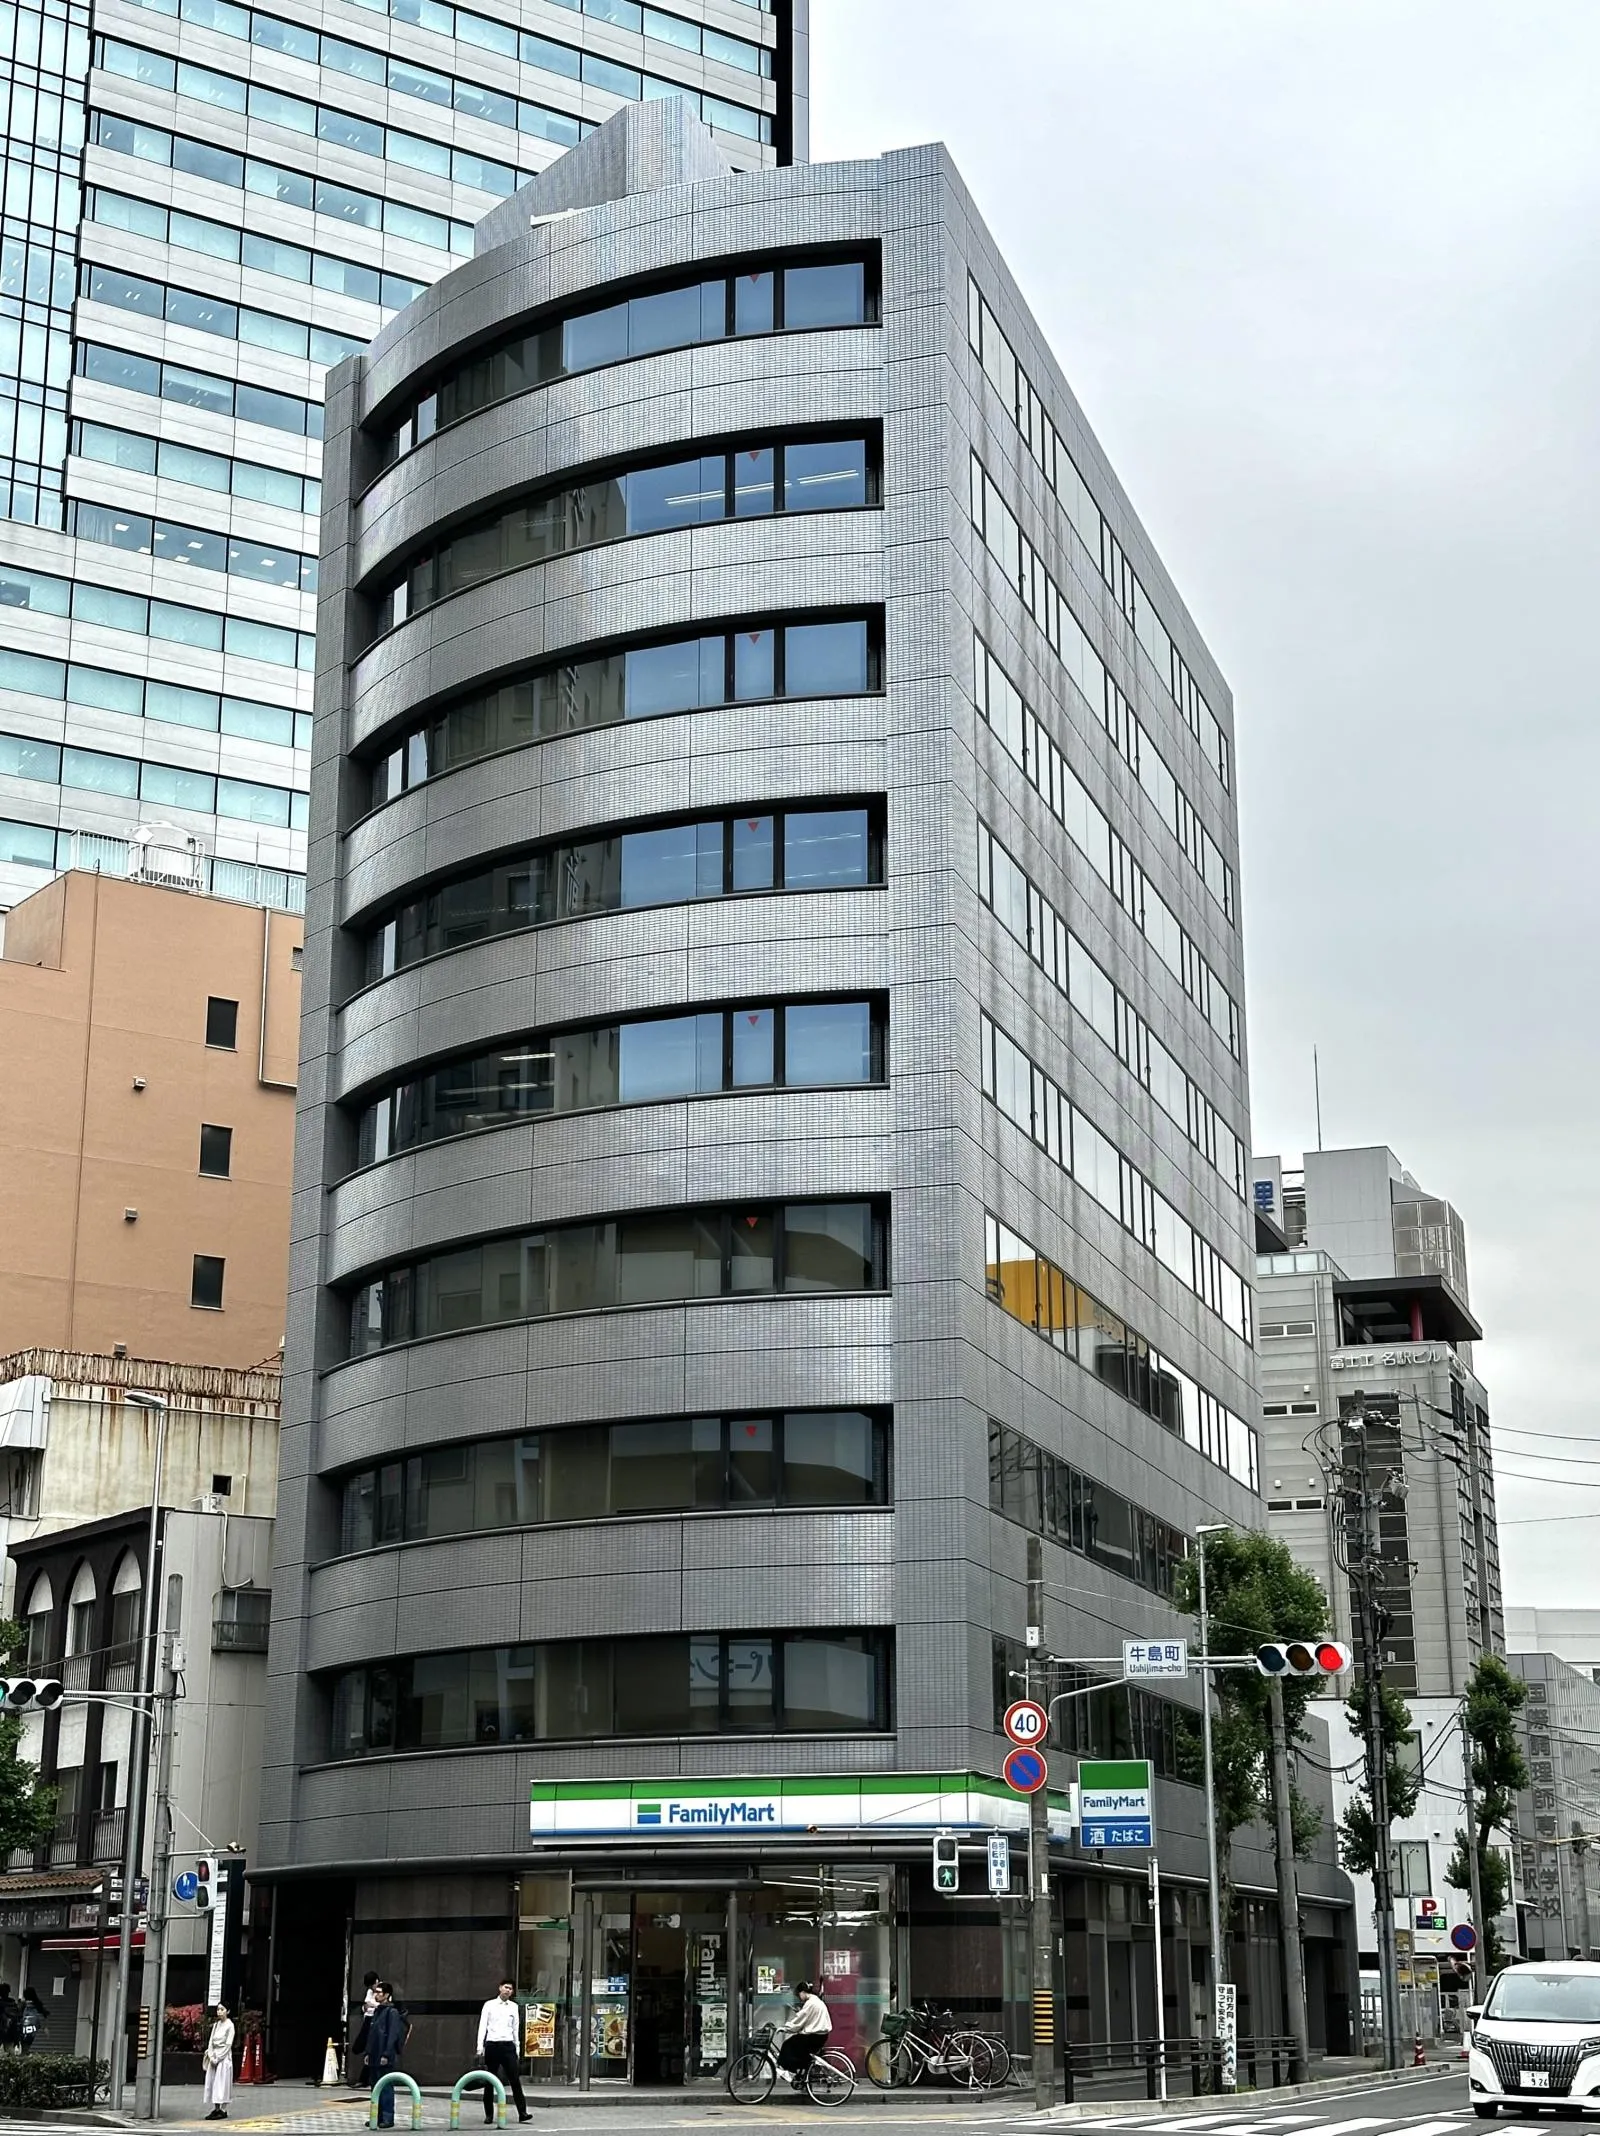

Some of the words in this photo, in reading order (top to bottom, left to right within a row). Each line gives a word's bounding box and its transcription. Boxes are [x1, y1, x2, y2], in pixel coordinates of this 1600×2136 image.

[1330, 1353, 1375, 1369] 富士工
[1381, 1350, 1441, 1366] 名駅ビル
[1130, 1646, 1180, 1661] 牛島町
[1129, 1664, 1182, 1674] Ushijima-cho
[1015, 1714, 1037, 1733] 40
[1083, 1796, 1145, 1810] FamilyMart
[669, 1802, 775, 1825] FamilyMart
[1089, 1828, 1105, 1844] 酒
[1111, 1830, 1145, 1842] たばこ
[1422, 1900, 1437, 1916] P
[1434, 1918, 1445, 1928] 空
[825, 1965, 847, 1974] ATM
